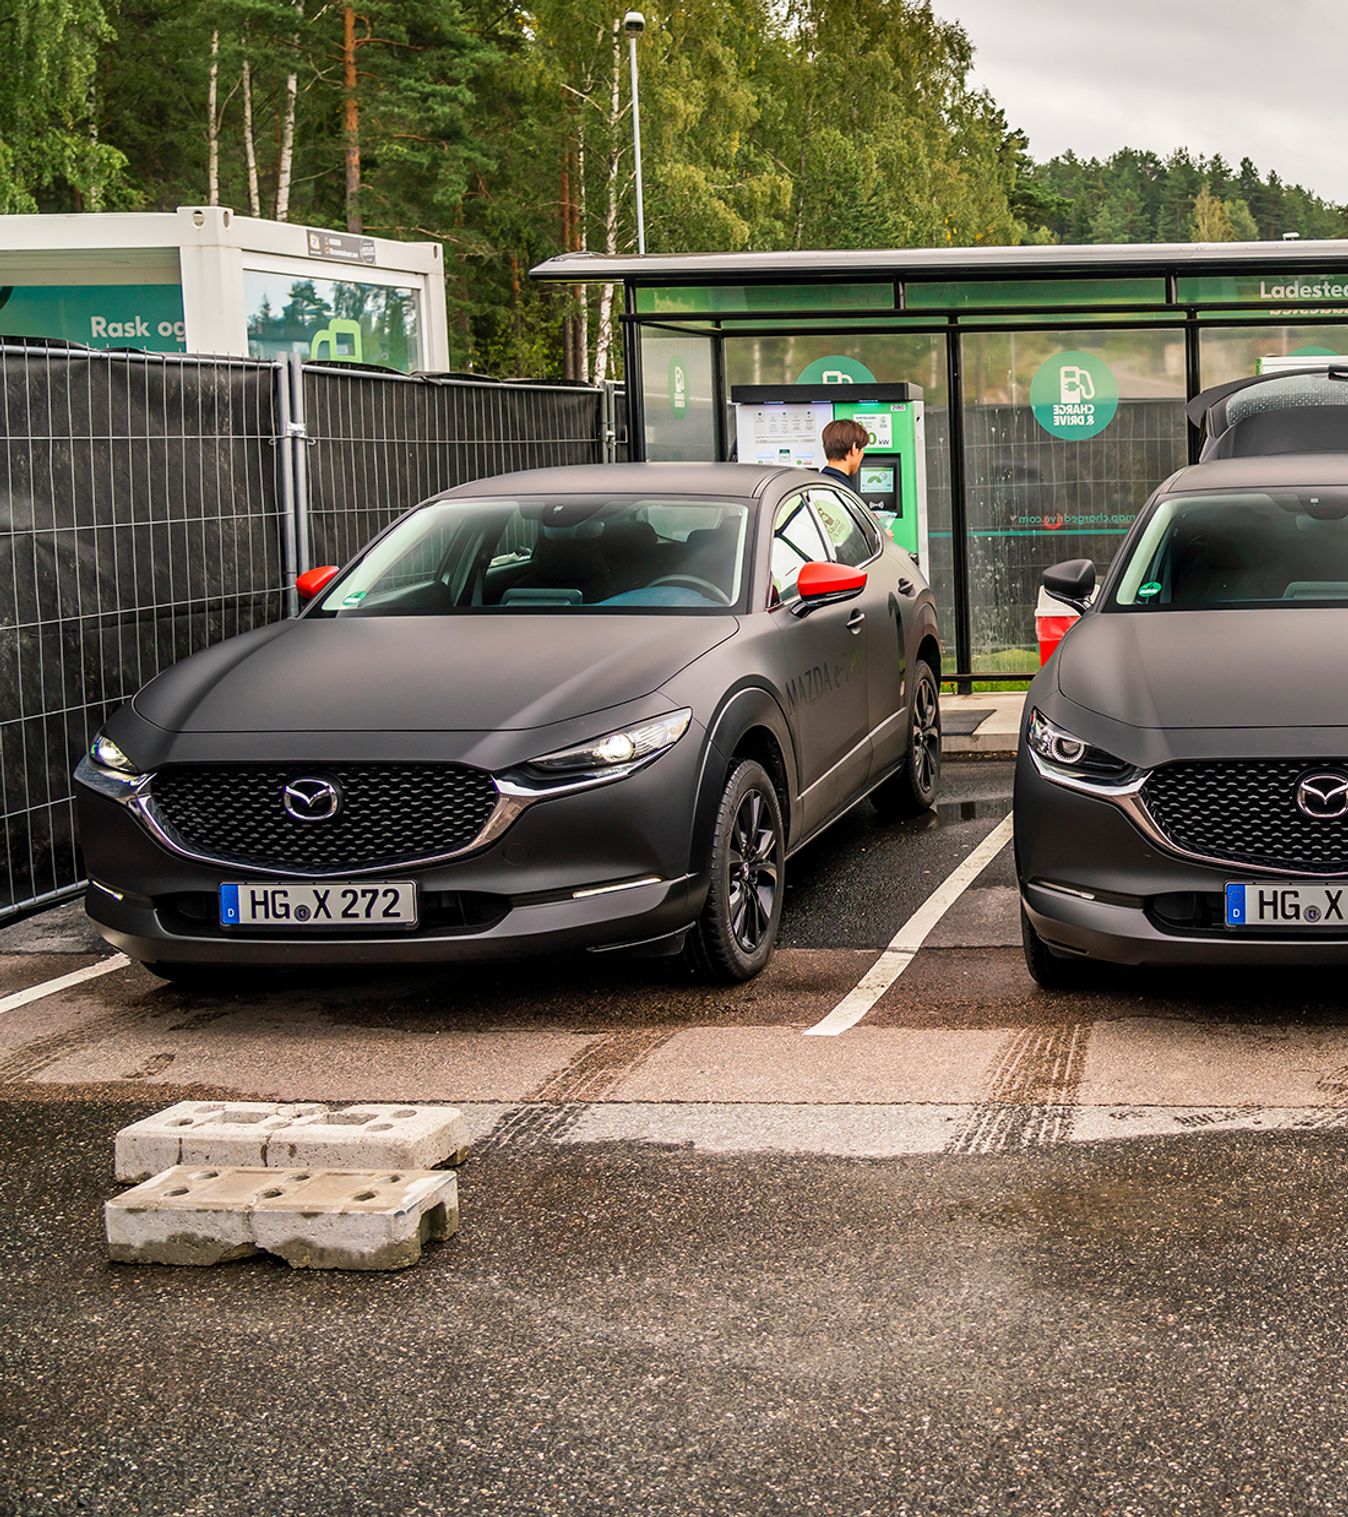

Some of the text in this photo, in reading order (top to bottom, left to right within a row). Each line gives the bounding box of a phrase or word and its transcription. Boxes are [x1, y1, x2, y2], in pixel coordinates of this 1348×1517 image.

[90, 315, 186, 342] Rask og
[785, 661, 833, 716] MAZDA
[227, 888, 401, 919] D HG X 272
[1232, 908, 1240, 918] D
[1258, 889, 1300, 920] HG
[1324, 889, 1344, 920] X
